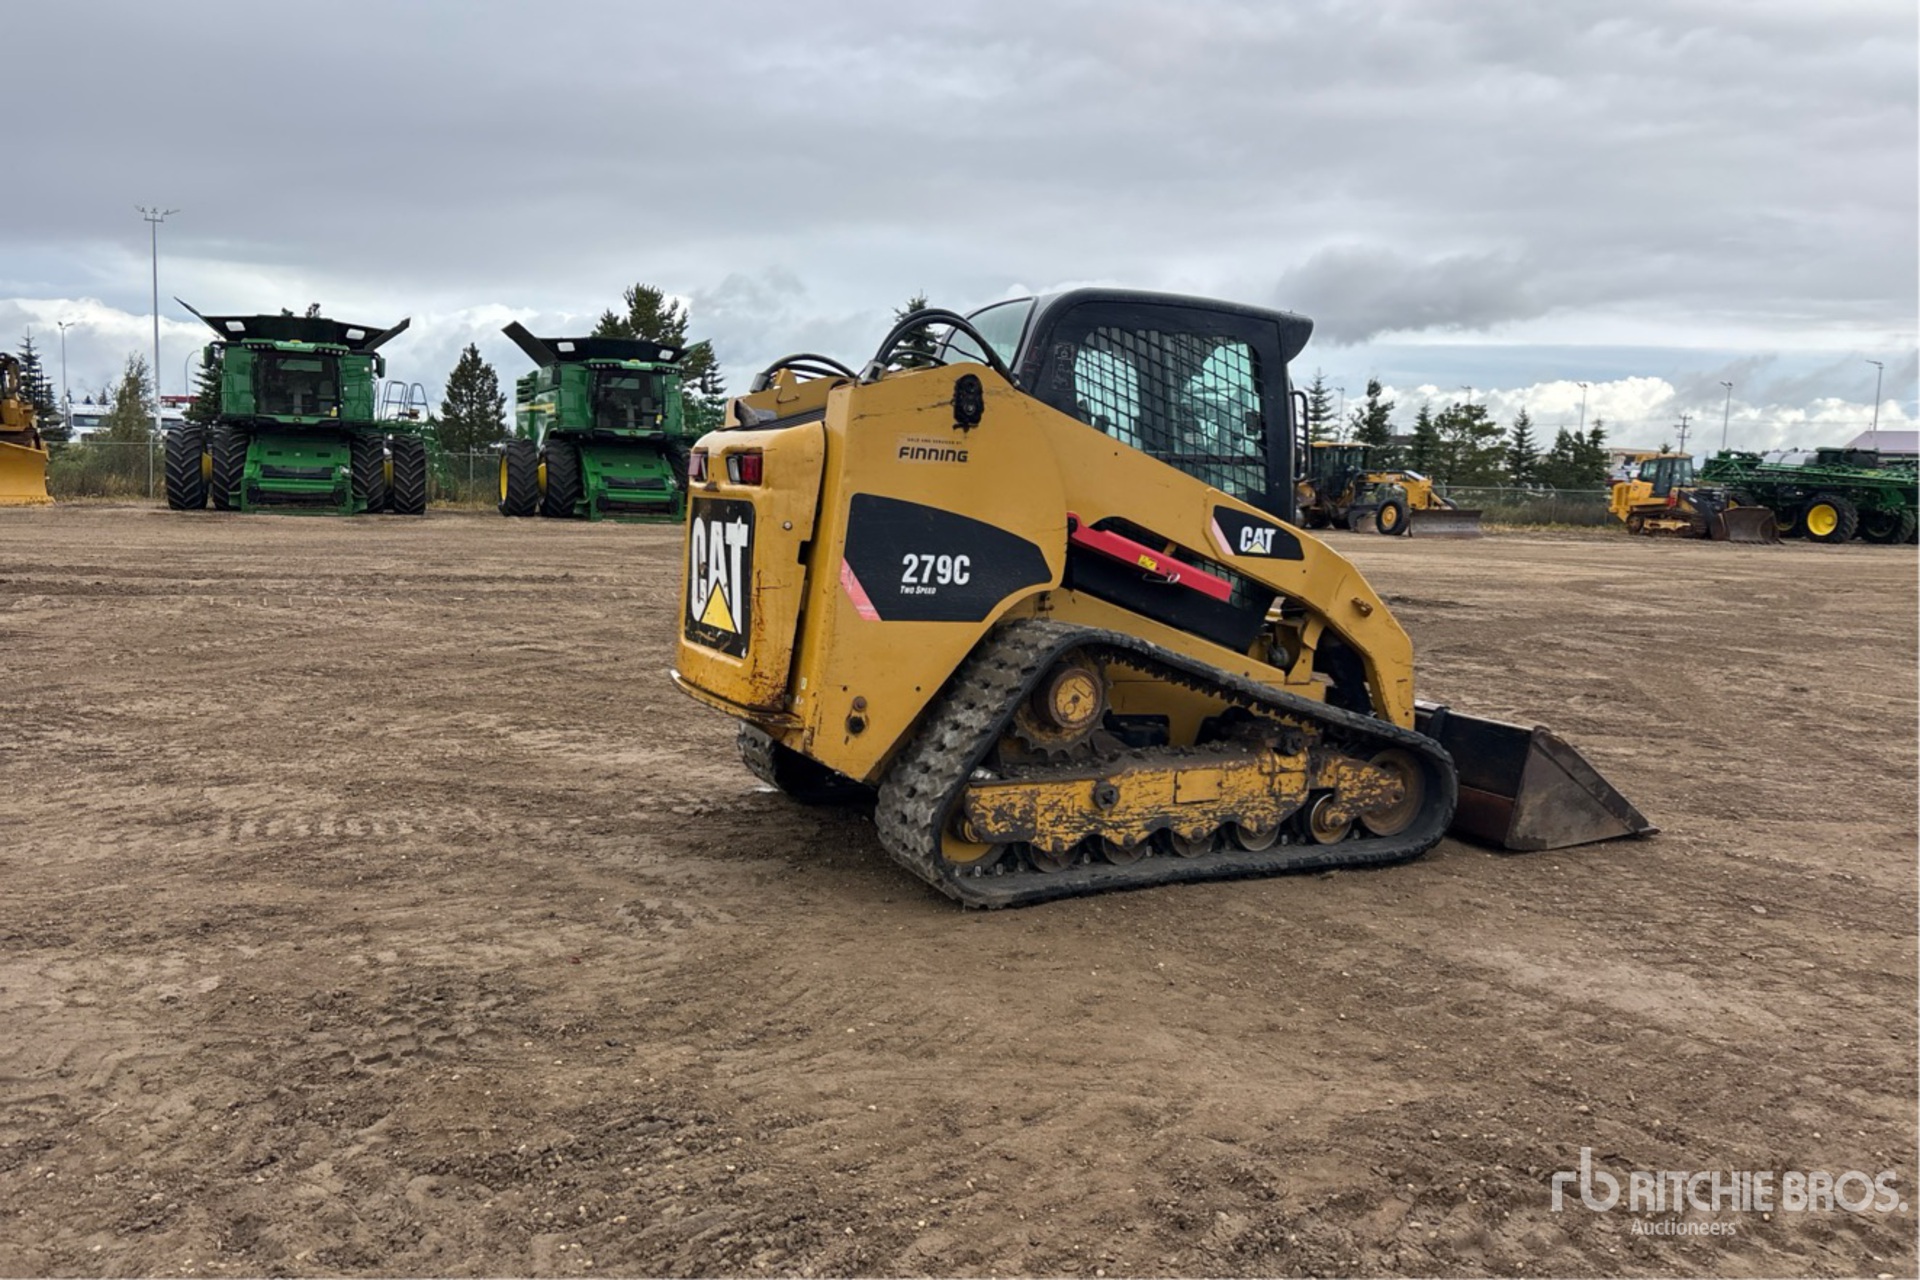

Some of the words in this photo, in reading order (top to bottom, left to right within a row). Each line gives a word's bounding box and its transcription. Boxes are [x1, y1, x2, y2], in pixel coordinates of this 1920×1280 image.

[898, 446, 969, 463] FINNING
[1239, 525, 1277, 555] CAT
[690, 515, 750, 635] CAT
[901, 553, 971, 586] 279C
